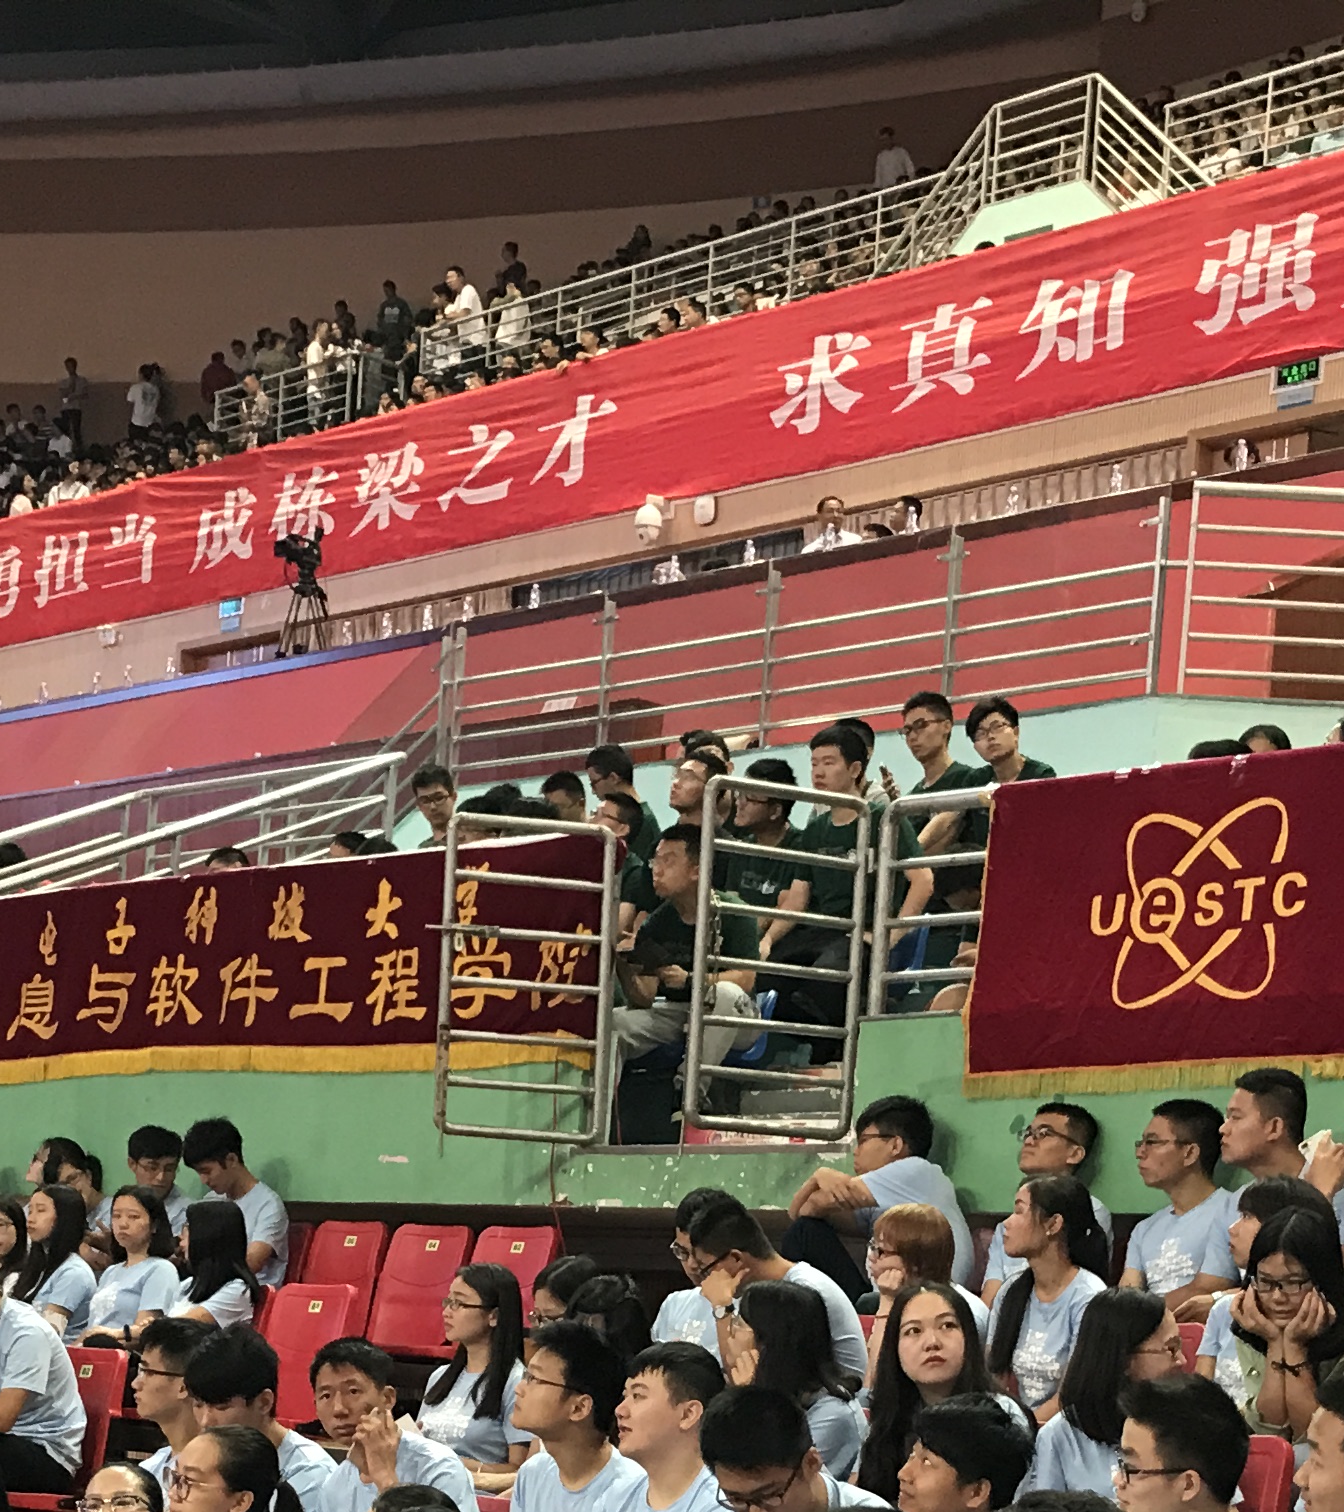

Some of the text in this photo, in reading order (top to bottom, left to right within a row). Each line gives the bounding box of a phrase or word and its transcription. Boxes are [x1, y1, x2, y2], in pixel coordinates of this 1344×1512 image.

[190, 395, 618, 573] 成栋梁之才
[769, 268, 1134, 436] 求真知
